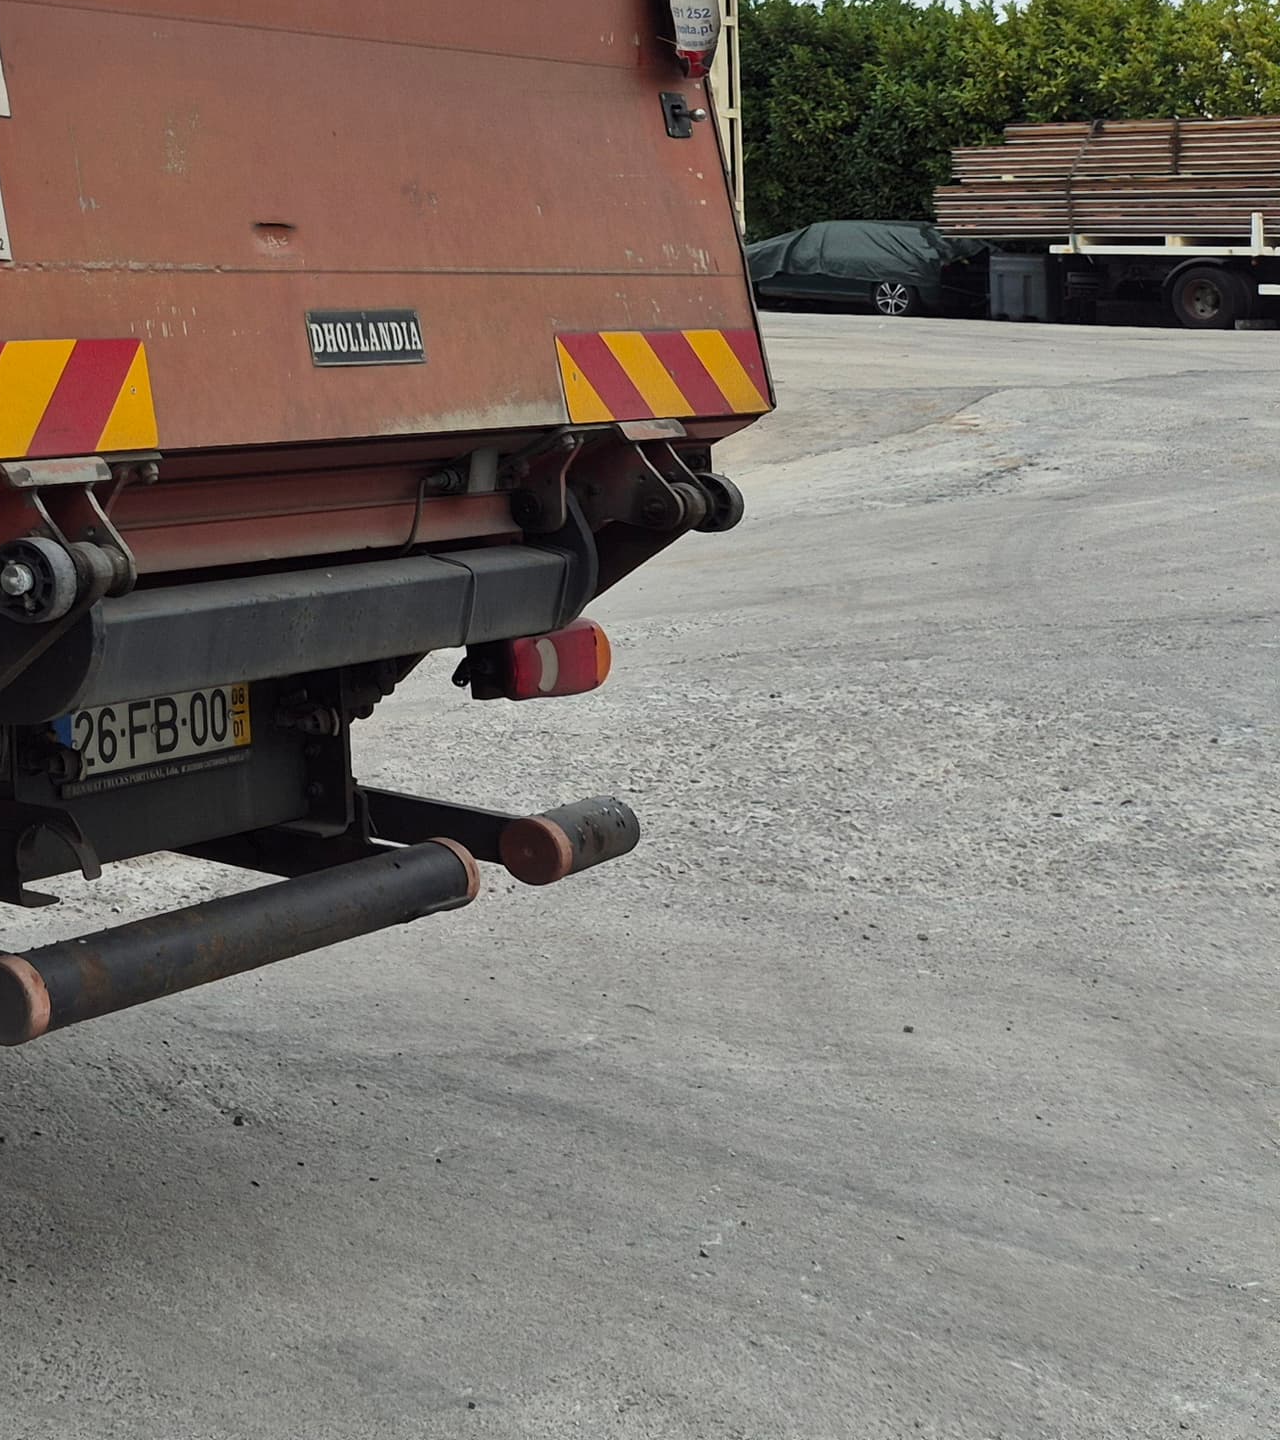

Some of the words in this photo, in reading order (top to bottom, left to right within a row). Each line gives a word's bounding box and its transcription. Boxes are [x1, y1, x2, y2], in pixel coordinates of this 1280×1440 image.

[687, 8, 712, 19] 252
[309, 320, 423, 353] DHOLLANDIA
[231, 687, 245, 705] 08
[233, 719, 244, 737] 01
